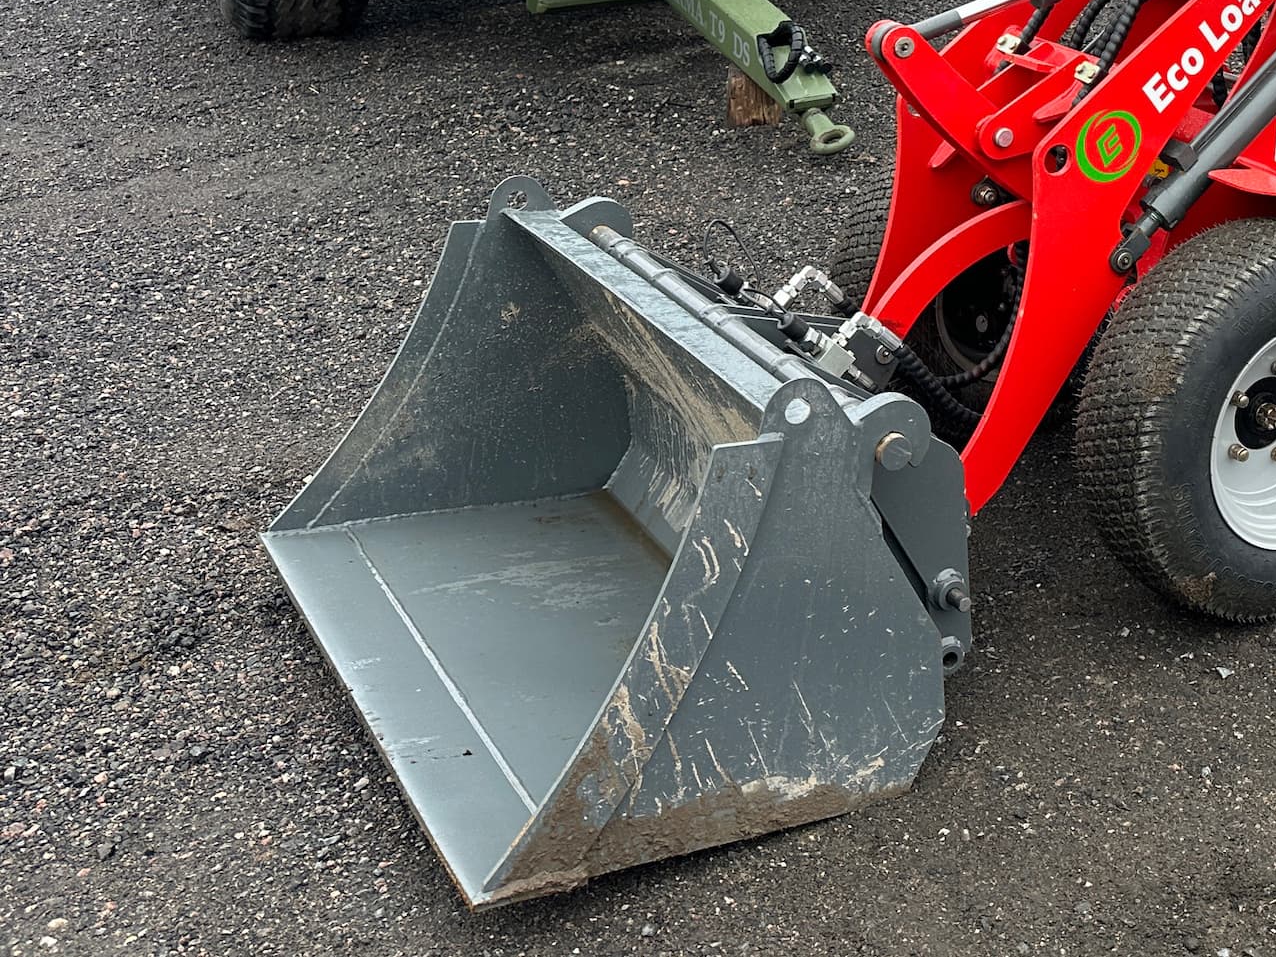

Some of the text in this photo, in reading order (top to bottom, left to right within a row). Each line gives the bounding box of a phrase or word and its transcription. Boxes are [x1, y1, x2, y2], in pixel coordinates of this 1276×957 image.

[708, 9, 726, 44] T9
[732, 29, 751, 68] DS
[1142, 47, 1204, 114] Eco
